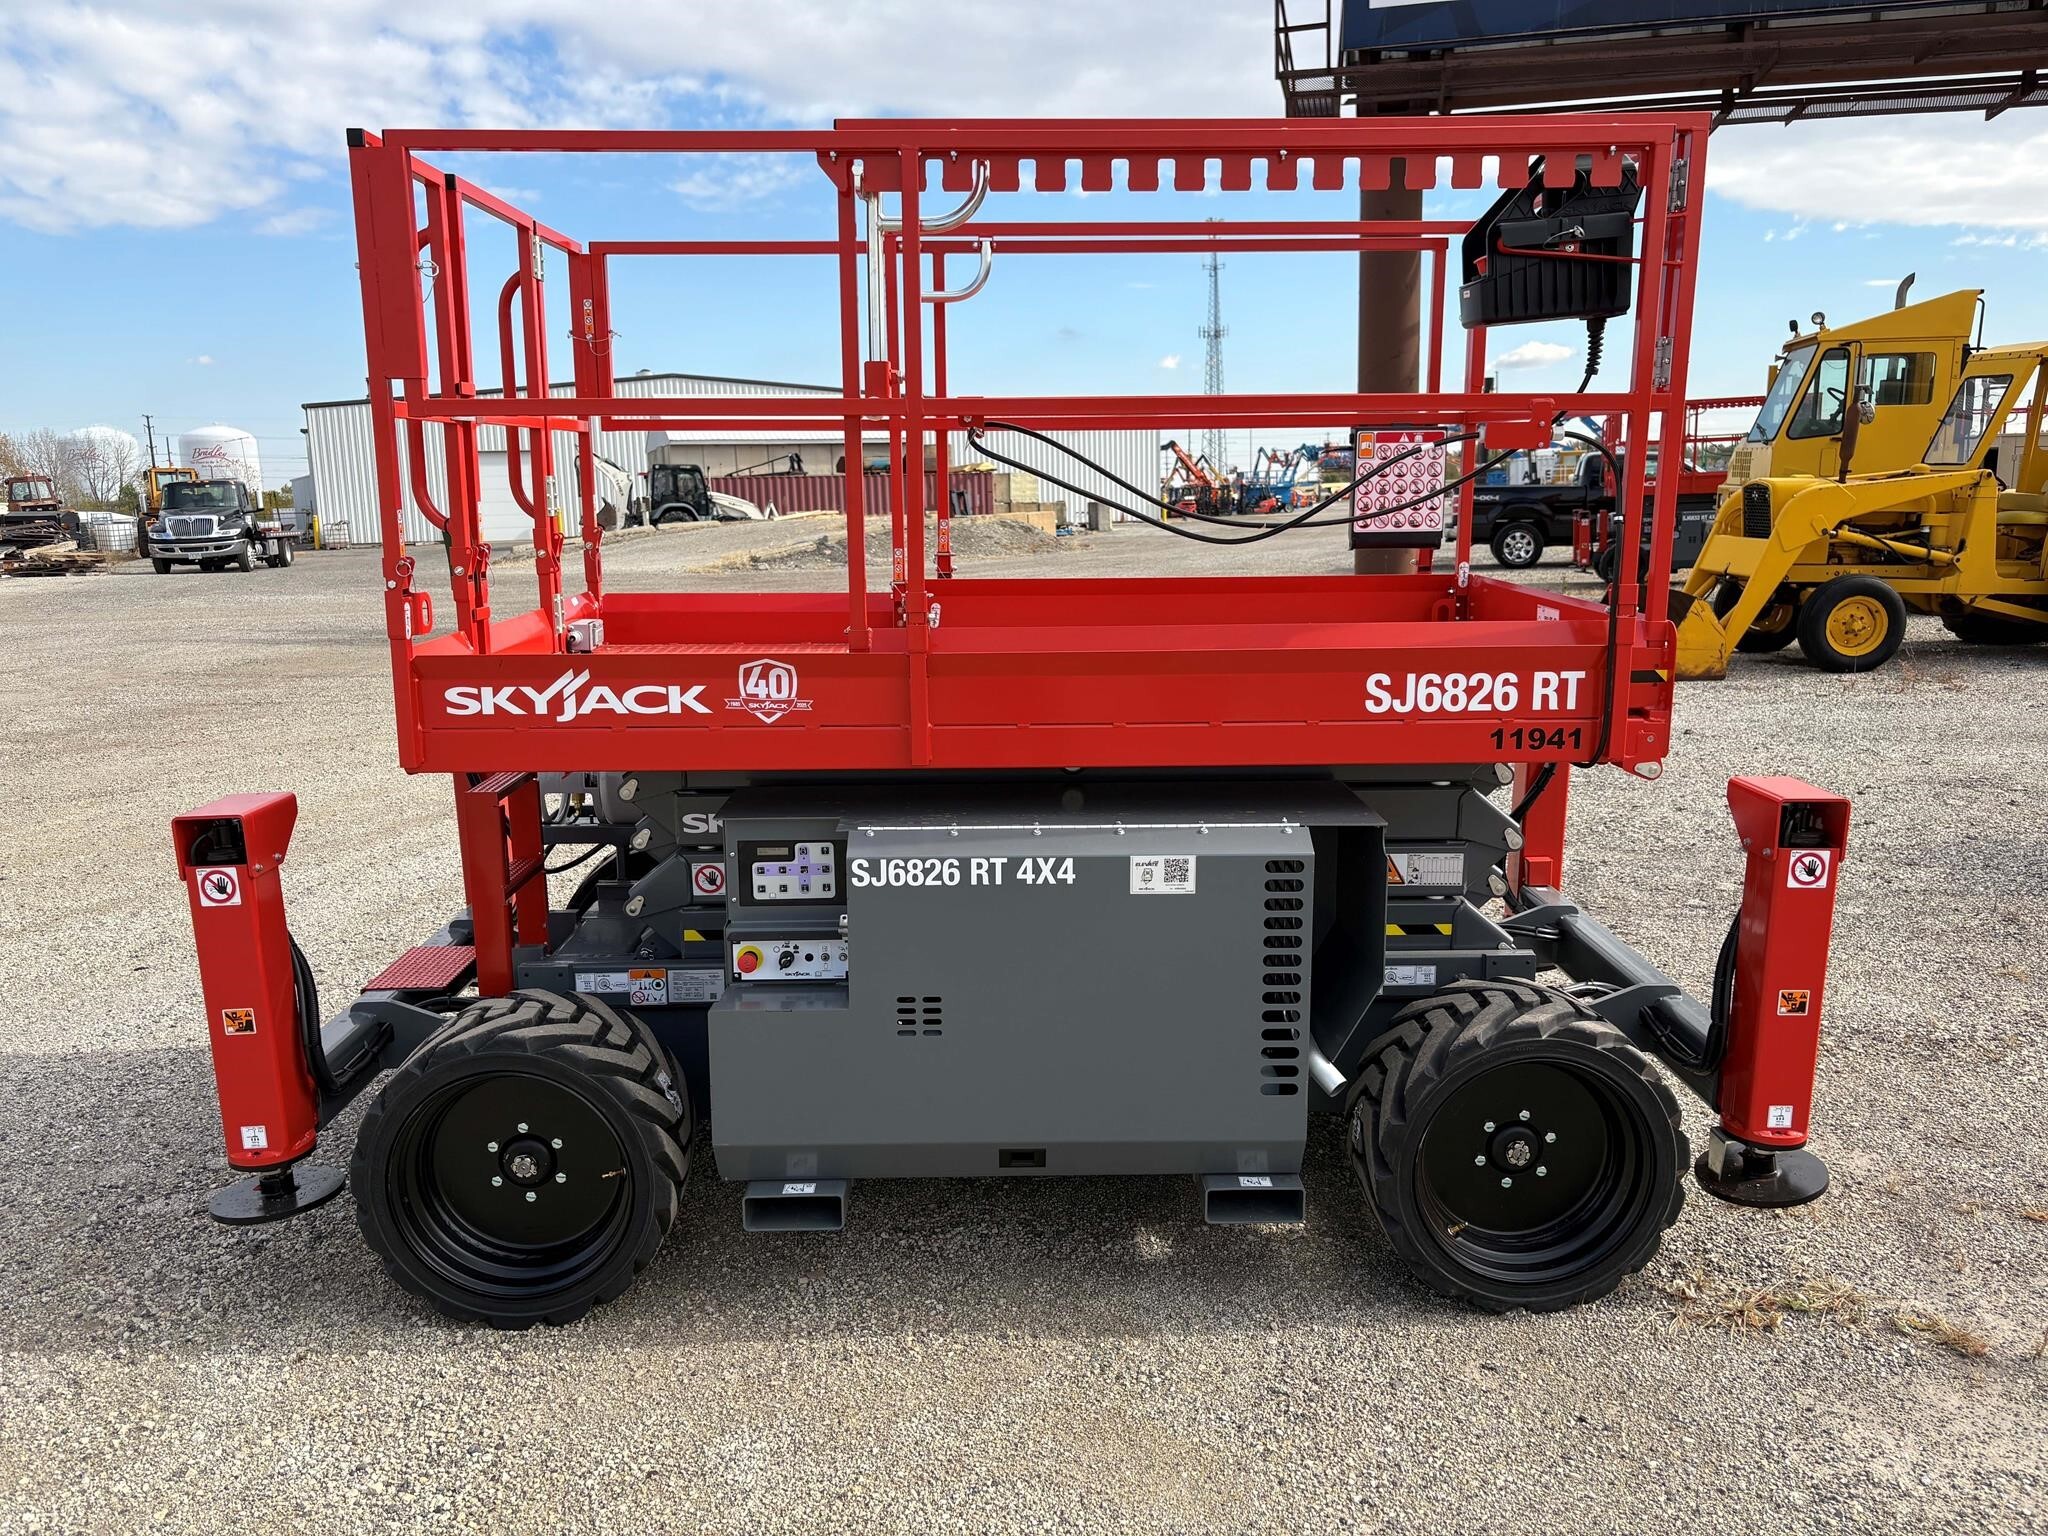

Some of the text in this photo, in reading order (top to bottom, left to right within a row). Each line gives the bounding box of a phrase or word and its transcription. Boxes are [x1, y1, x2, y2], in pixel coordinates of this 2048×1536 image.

[192, 444, 227, 459] Bradley
[444, 668, 713, 722] SKYJACK
[745, 665, 790, 700] 40
[1364, 671, 1586, 714] SJ6826 RT
[748, 701, 788, 709] SKYJACK
[1490, 727, 1582, 750] 11941
[851, 857, 1076, 887] SJ6826 RT 4X4
